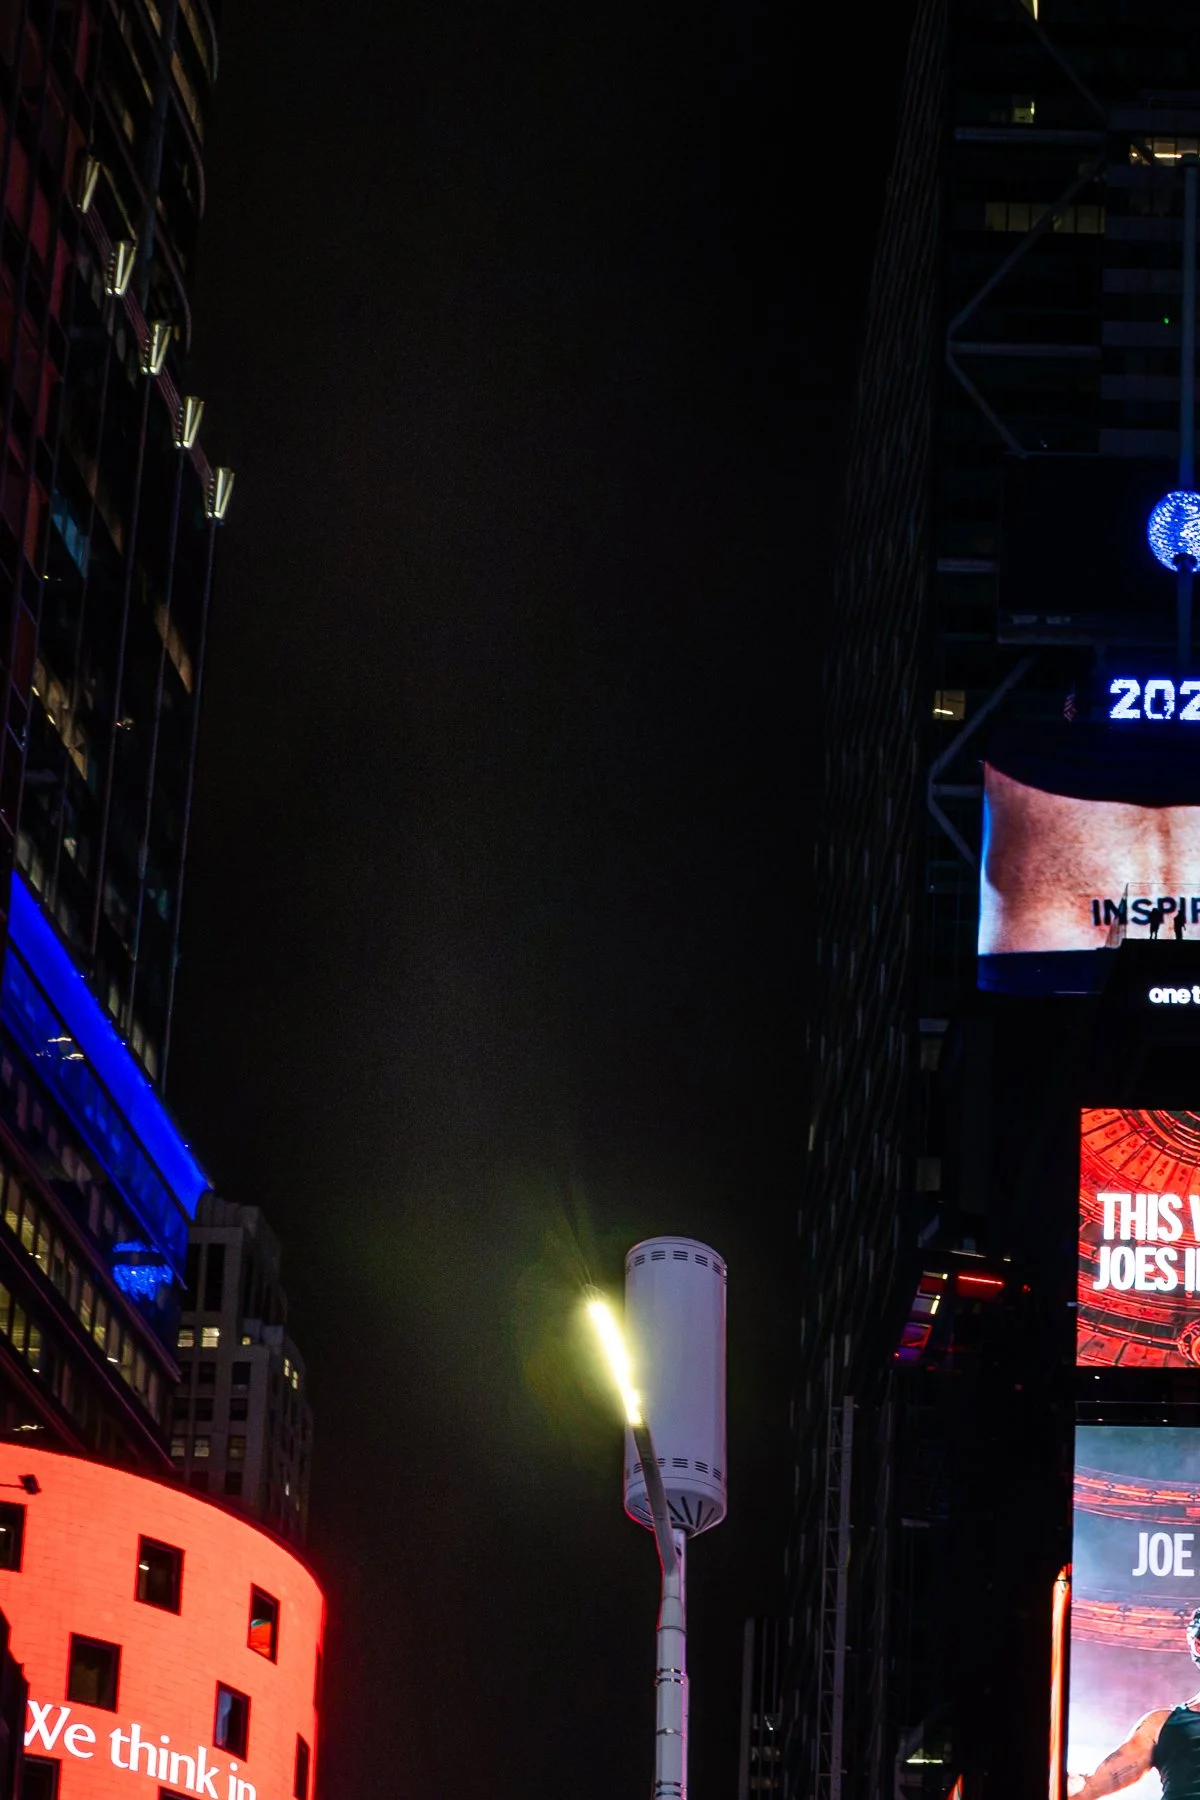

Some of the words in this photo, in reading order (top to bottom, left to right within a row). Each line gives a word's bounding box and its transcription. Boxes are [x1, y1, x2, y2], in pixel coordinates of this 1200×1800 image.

[1149, 986, 1191, 1005] one
[1096, 1192, 1184, 1242] THIS
[1092, 1245, 1179, 1291] JOES
[1131, 1532, 1195, 1578] JOE
[24, 1699, 97, 1759] We
[109, 1722, 221, 1800] think
